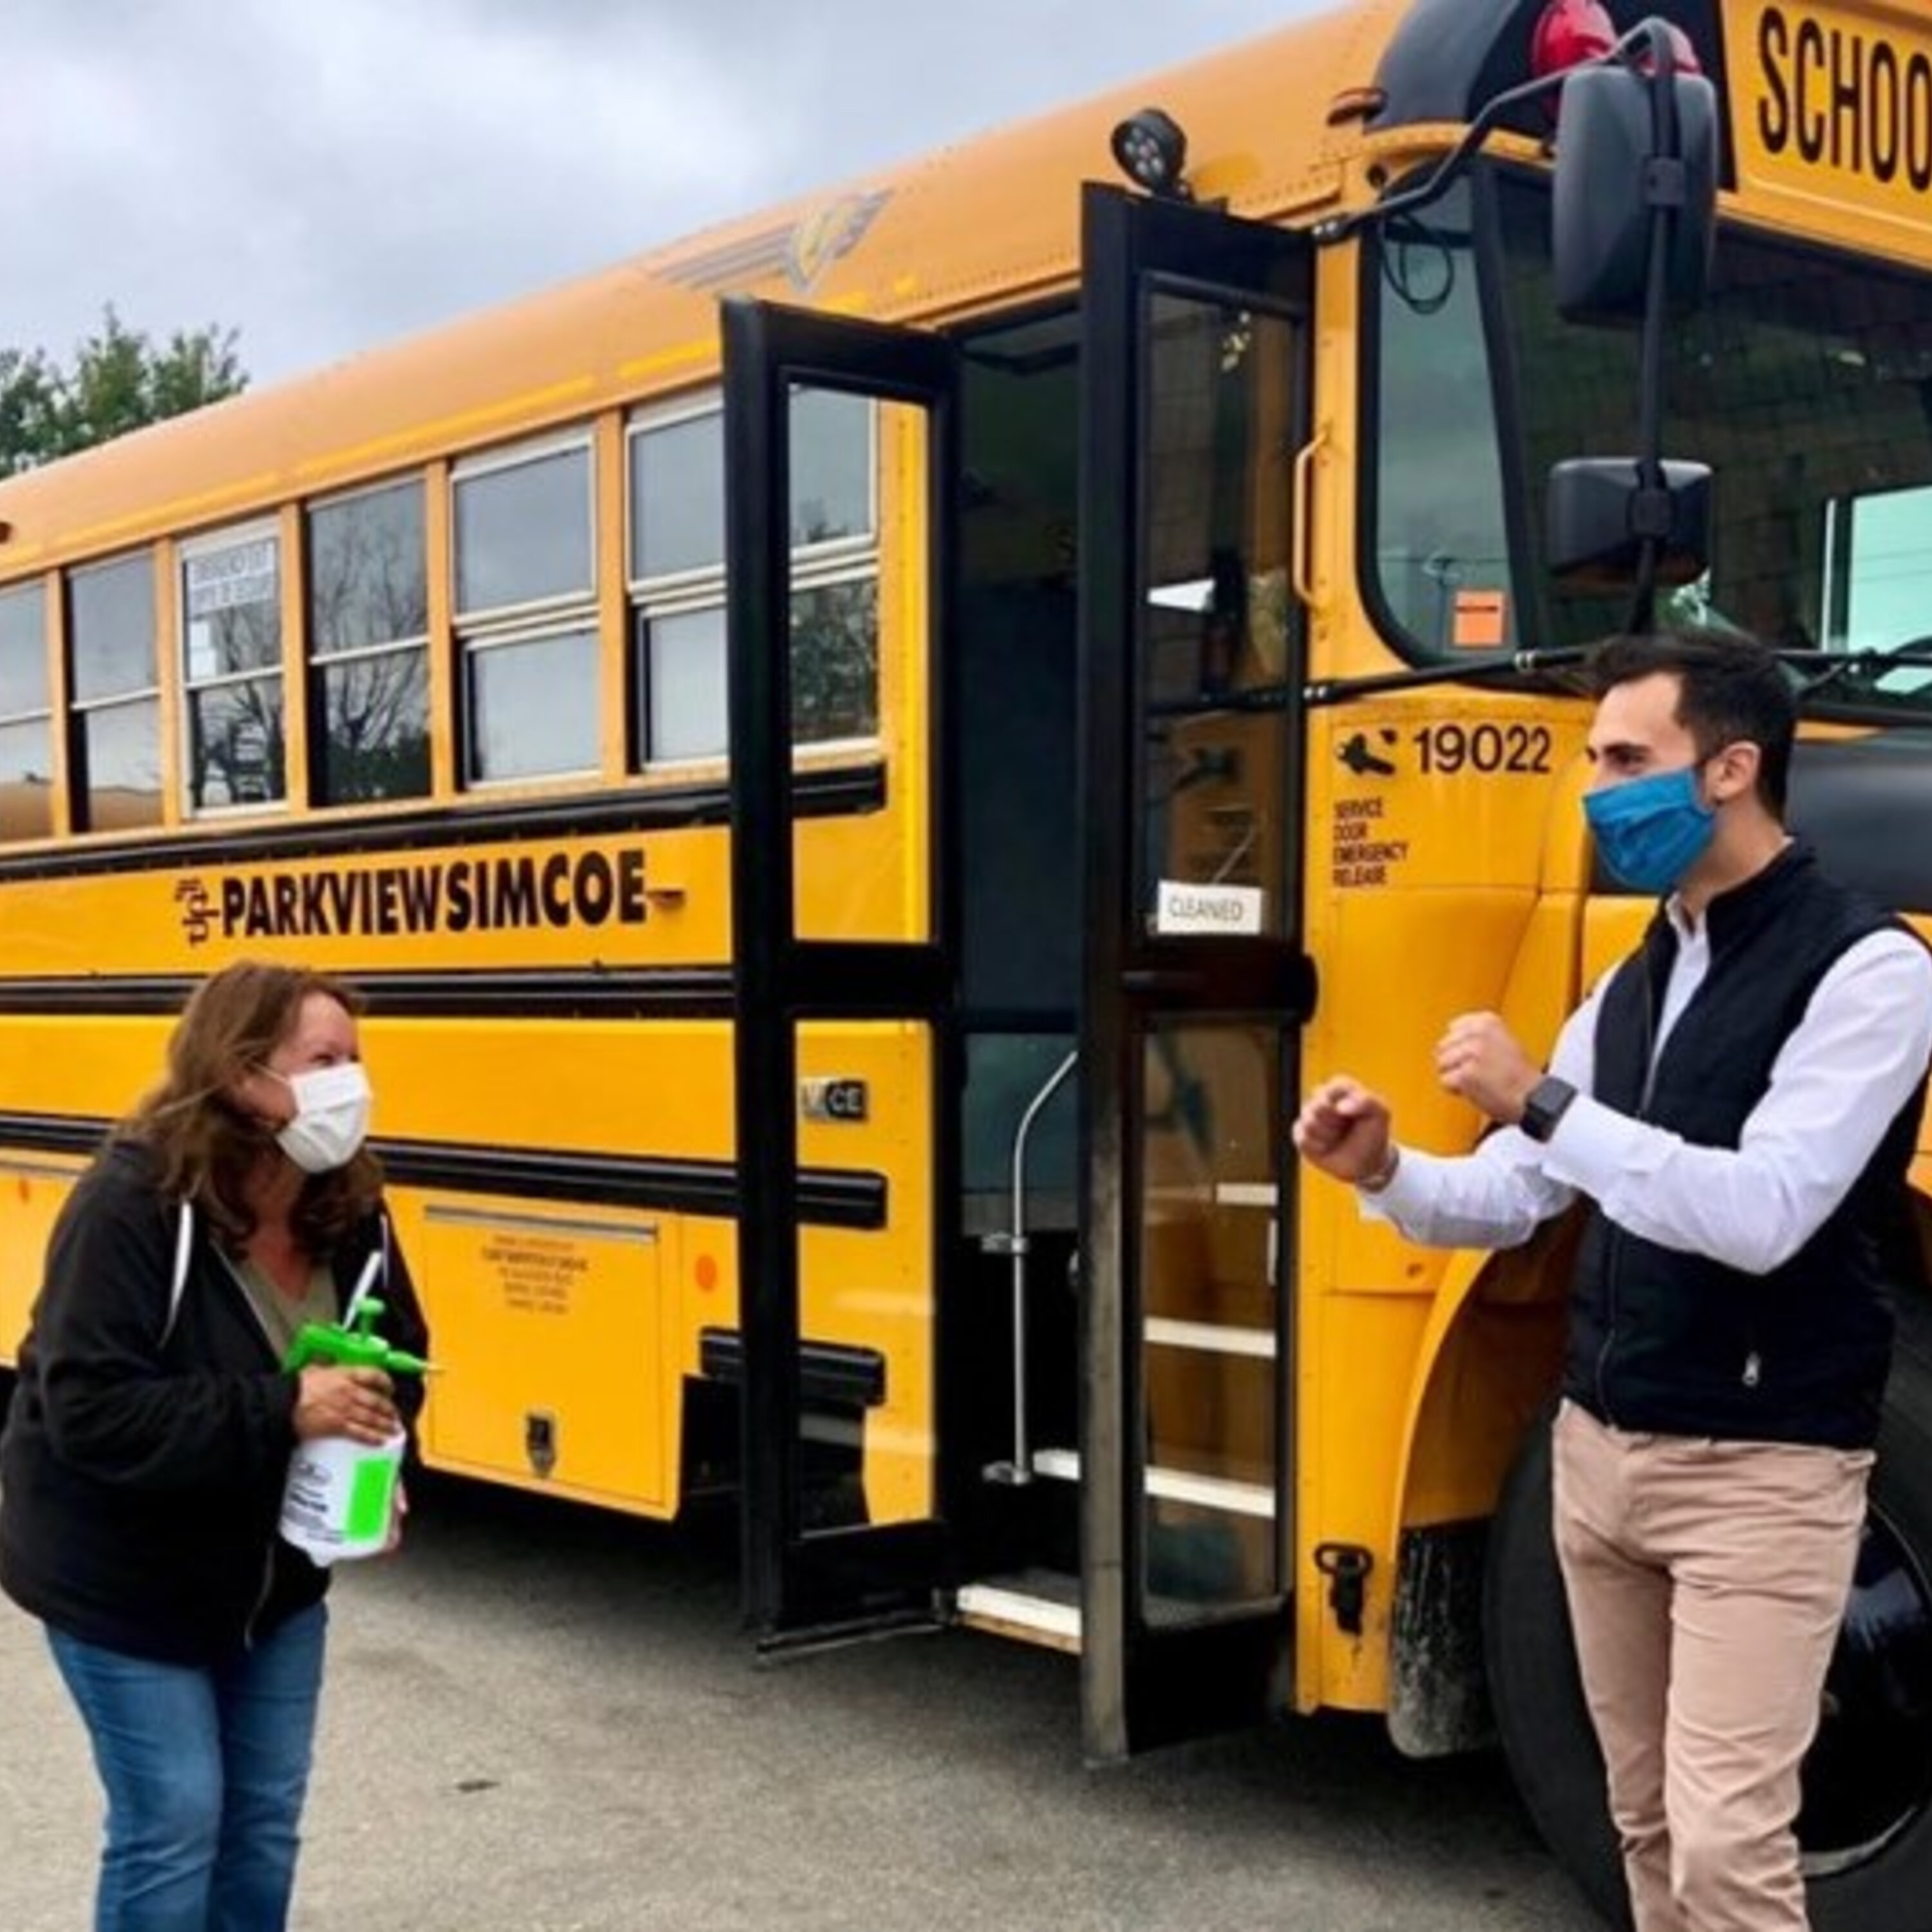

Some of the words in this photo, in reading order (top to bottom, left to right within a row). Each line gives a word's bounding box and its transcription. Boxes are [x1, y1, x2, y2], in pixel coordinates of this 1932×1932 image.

[1758, 7, 1932, 193] SCHOO
[1414, 724, 1550, 773] 19022
[1334, 797, 1383, 819] SERVICE
[1333, 822, 1367, 840] DOOR
[1333, 841, 1409, 865] EMERGENCY
[1333, 866, 1387, 887] RELEASE
[1170, 895, 1244, 922] CLEANED
